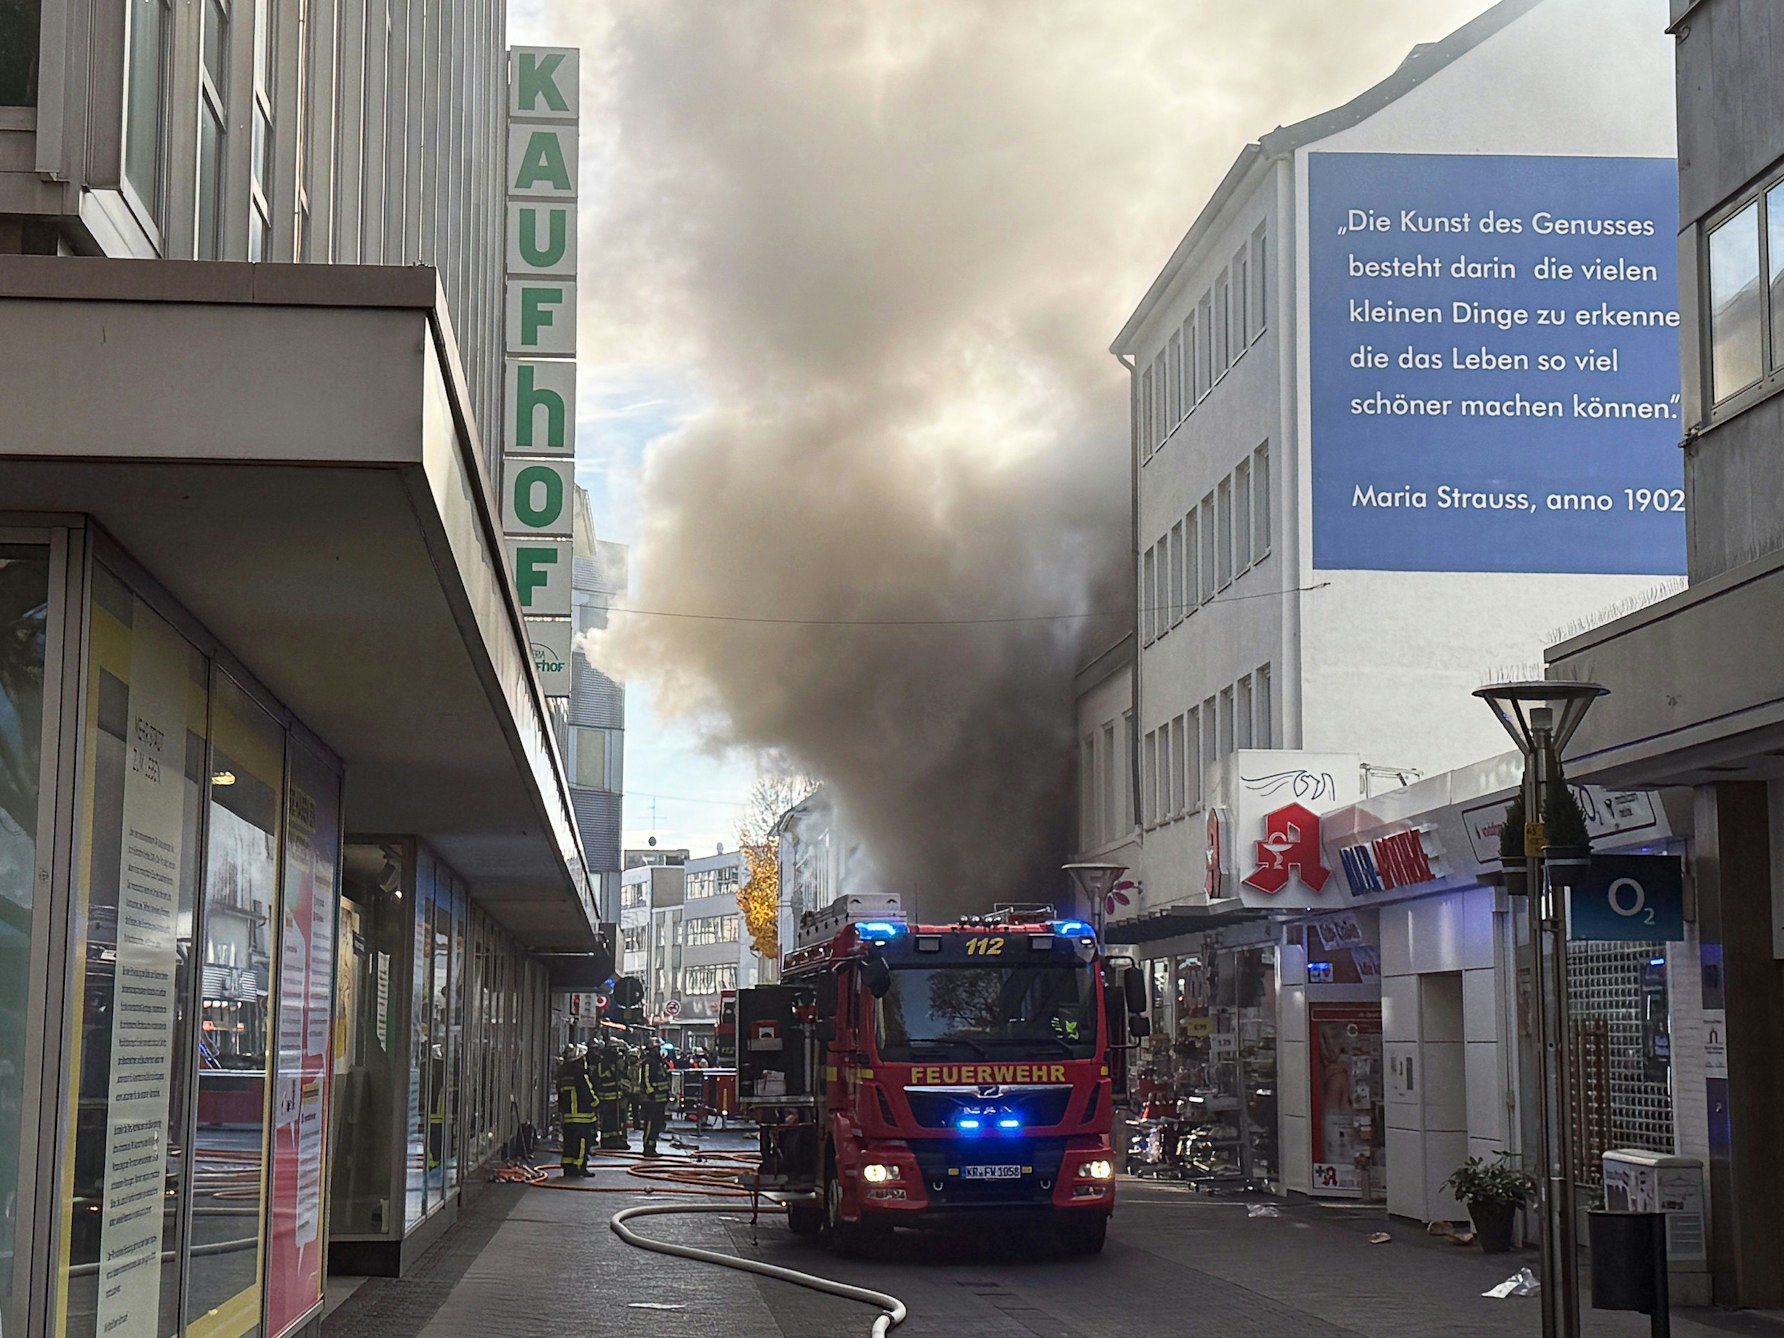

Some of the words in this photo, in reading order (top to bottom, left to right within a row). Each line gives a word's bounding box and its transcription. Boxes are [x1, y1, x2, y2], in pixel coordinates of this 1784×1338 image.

[1401, 210, 1471, 233] Kunst
[1479, 210, 1523, 234] des
[1531, 211, 1655, 236] Genusses
[1349, 253, 1442, 278] besteht
[1450, 254, 1516, 279] darin
[1534, 256, 1573, 280] die
[1581, 257, 1657, 281] vielen
[1349, 299, 1442, 323] kleinen
[1452, 301, 1529, 330] Dinge
[1536, 309, 1566, 325] zu
[1575, 302, 1681, 327] erkenne
[1350, 345, 1389, 369] die
[1398, 345, 1443, 370] das
[1452, 347, 1529, 371] Leben
[1537, 355, 1567, 371] so
[1574, 348, 1619, 372] viel
[1350, 391, 1453, 416] schöner
[1460, 392, 1564, 417] machen
[1351, 484, 1428, 509] Maria
[1437, 485, 1538, 515] Strauss,
[1546, 494, 1614, 511] anno
[1623, 488, 1686, 512] 1902
[1607, 877, 1656, 926] O2
[966, 937, 1005, 956] 112
[911, 1064, 1066, 1084] FEUERWEHR
